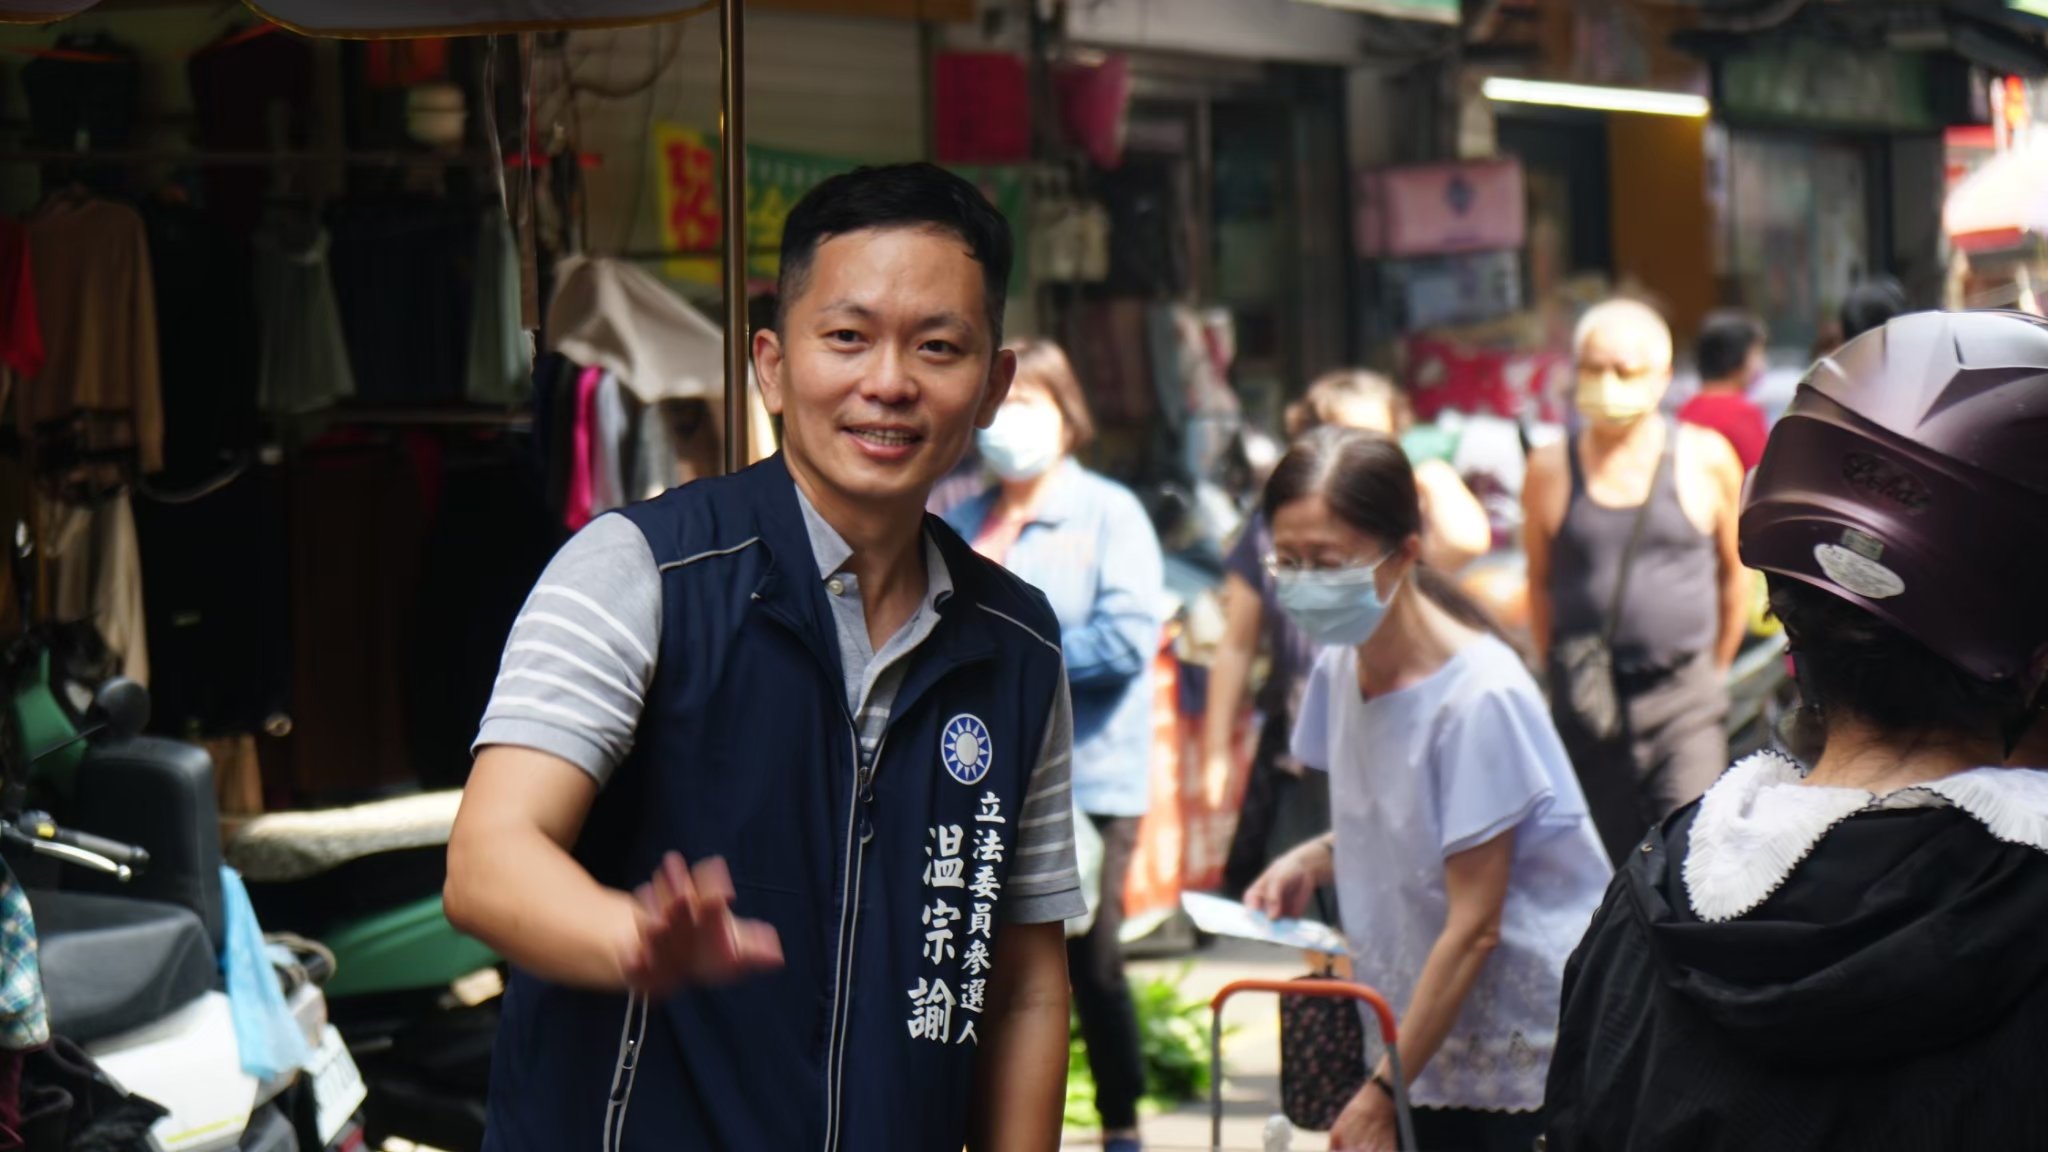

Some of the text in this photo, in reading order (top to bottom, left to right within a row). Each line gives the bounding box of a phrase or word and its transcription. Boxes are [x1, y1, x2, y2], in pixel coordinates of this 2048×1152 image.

[956, 791, 1006, 1046] 立法委員參選人
